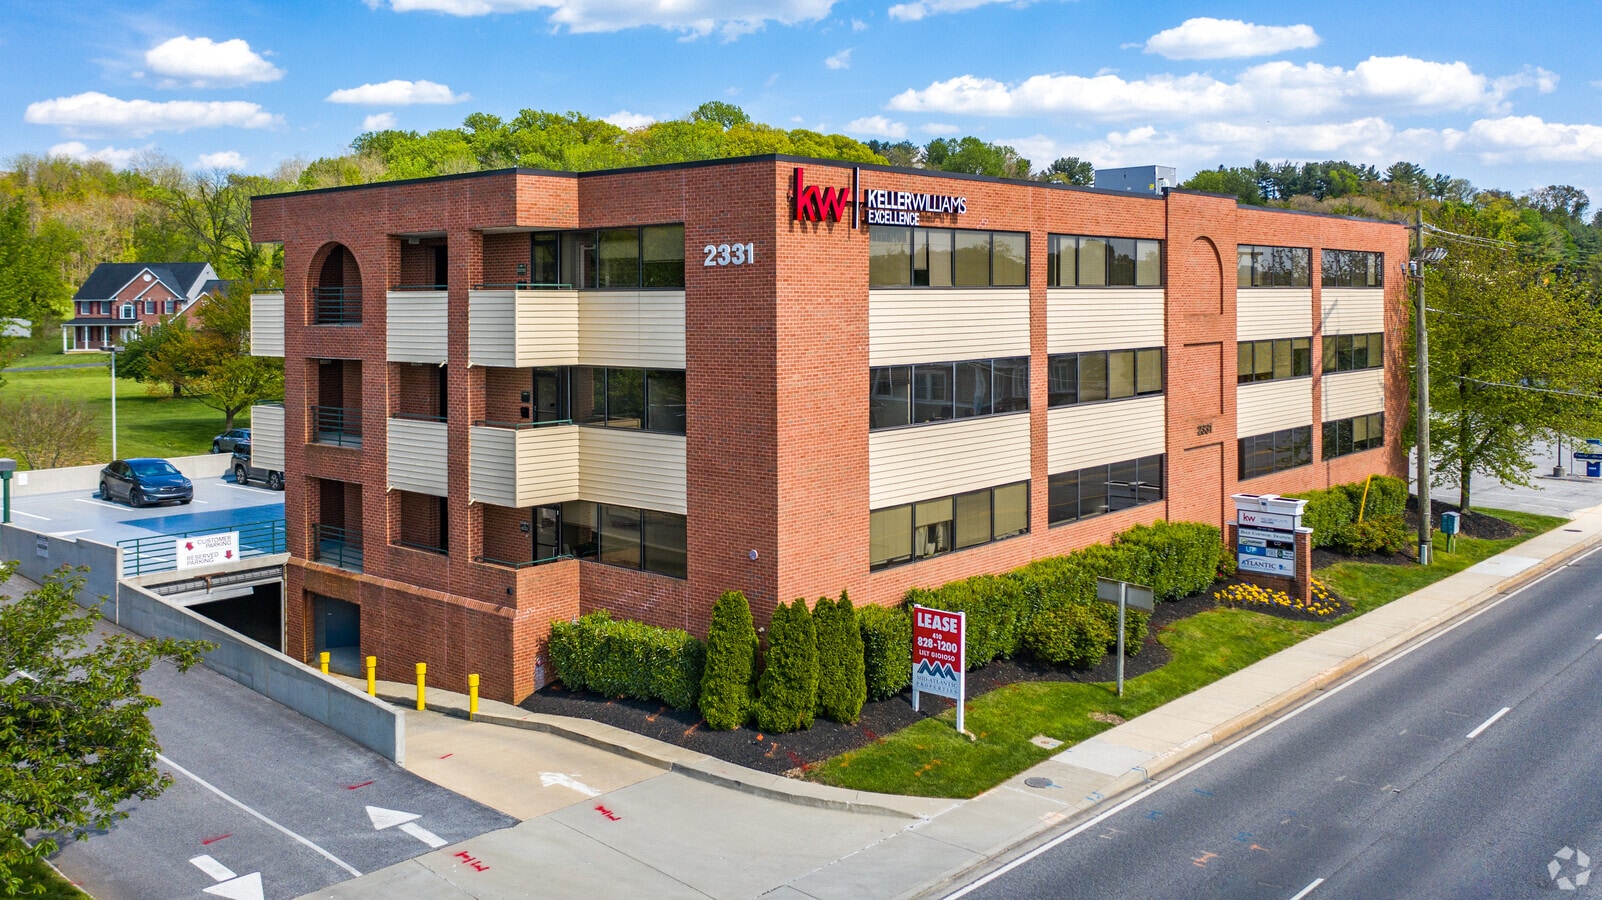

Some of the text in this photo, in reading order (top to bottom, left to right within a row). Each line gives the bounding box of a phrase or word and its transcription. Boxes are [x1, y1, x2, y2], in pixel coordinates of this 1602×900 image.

[794, 168, 850, 222] kw
[868, 209, 920, 226] EXCELLENCE
[704, 242, 754, 266] 2331
[1243, 512, 1256, 522] kw
[197, 535, 232, 545] CUSTOMER
[205, 541, 232, 549] PARKING
[186, 551, 219, 561] RESERVED
[186, 557, 215, 566] PARKING
[1241, 559, 1277, 569] ATLANTIC
[917, 612, 957, 634] LEASE
[932, 632, 942, 640] 410
[917, 636, 957, 653] 828-1200
[919, 649, 930, 657] LILY
